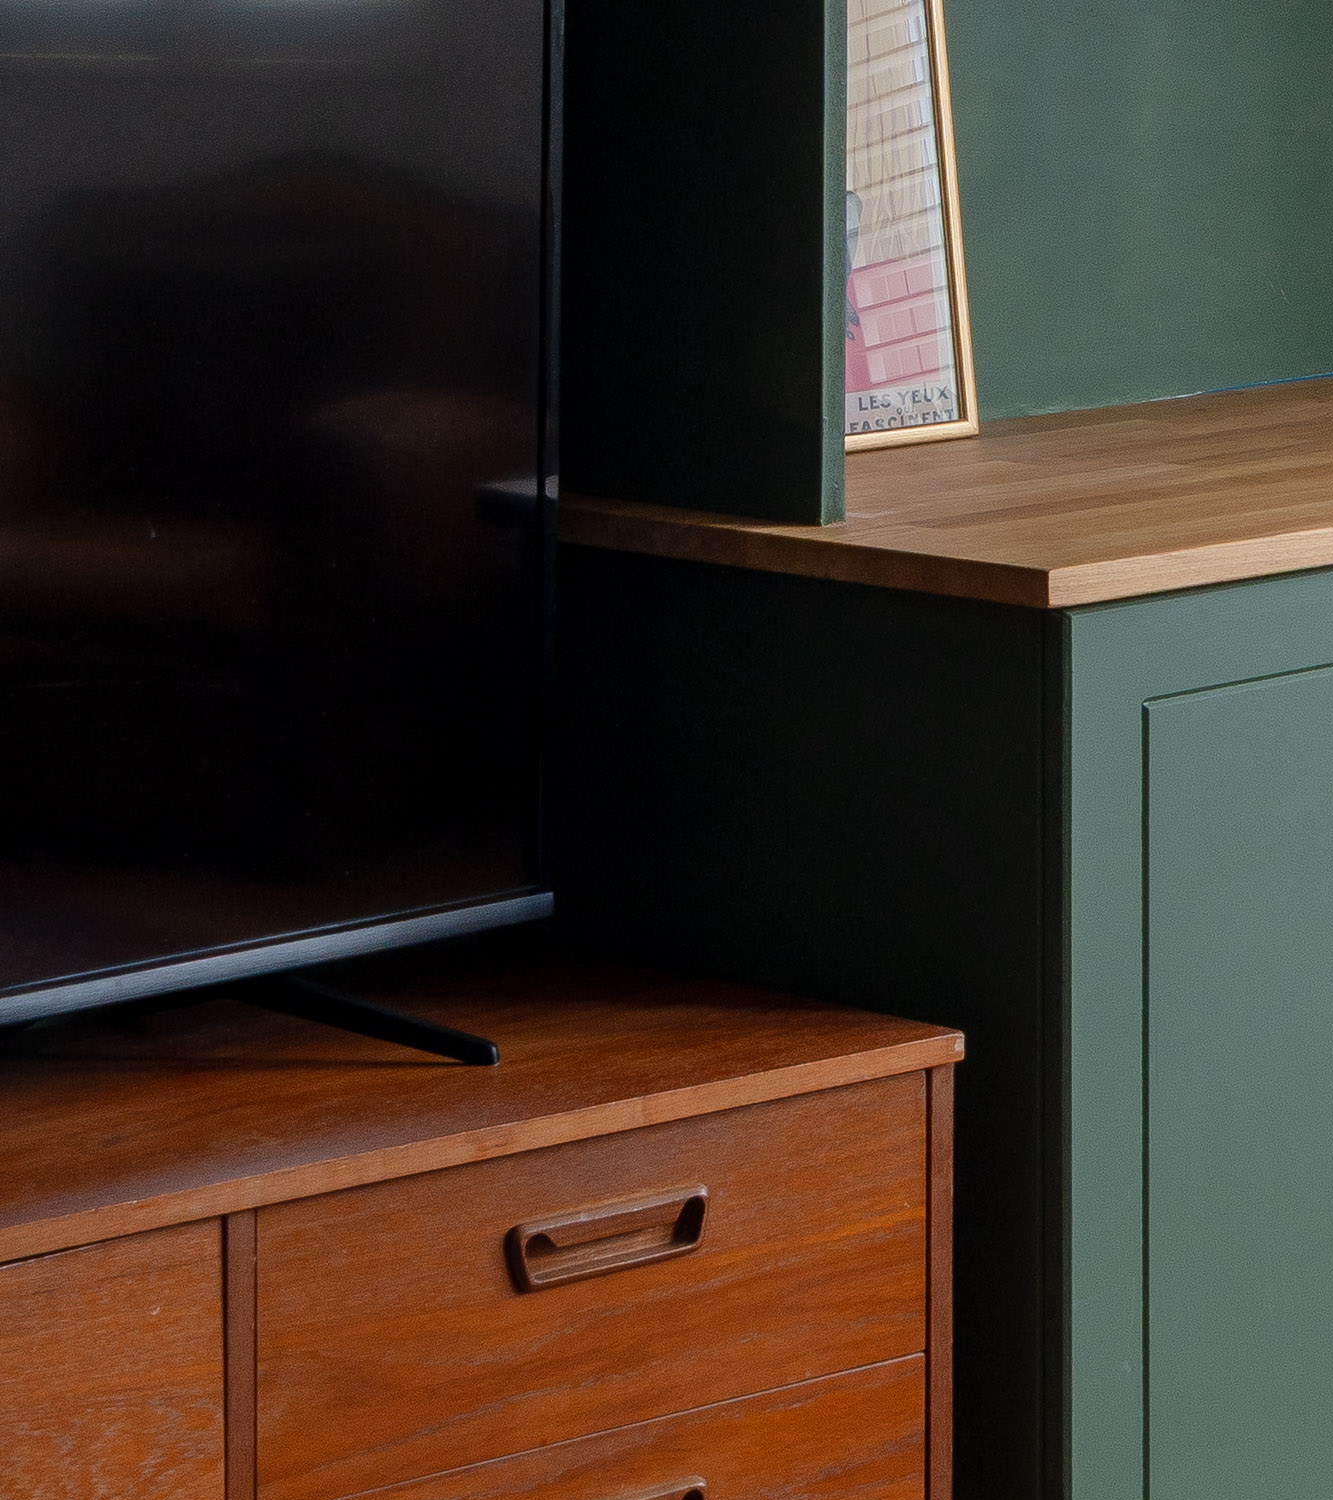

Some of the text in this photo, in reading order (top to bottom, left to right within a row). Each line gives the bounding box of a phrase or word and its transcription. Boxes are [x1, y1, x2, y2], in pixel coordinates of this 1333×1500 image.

[858, 386, 949, 411] LES YEUX
[849, 409, 954, 432] FASCINENT
